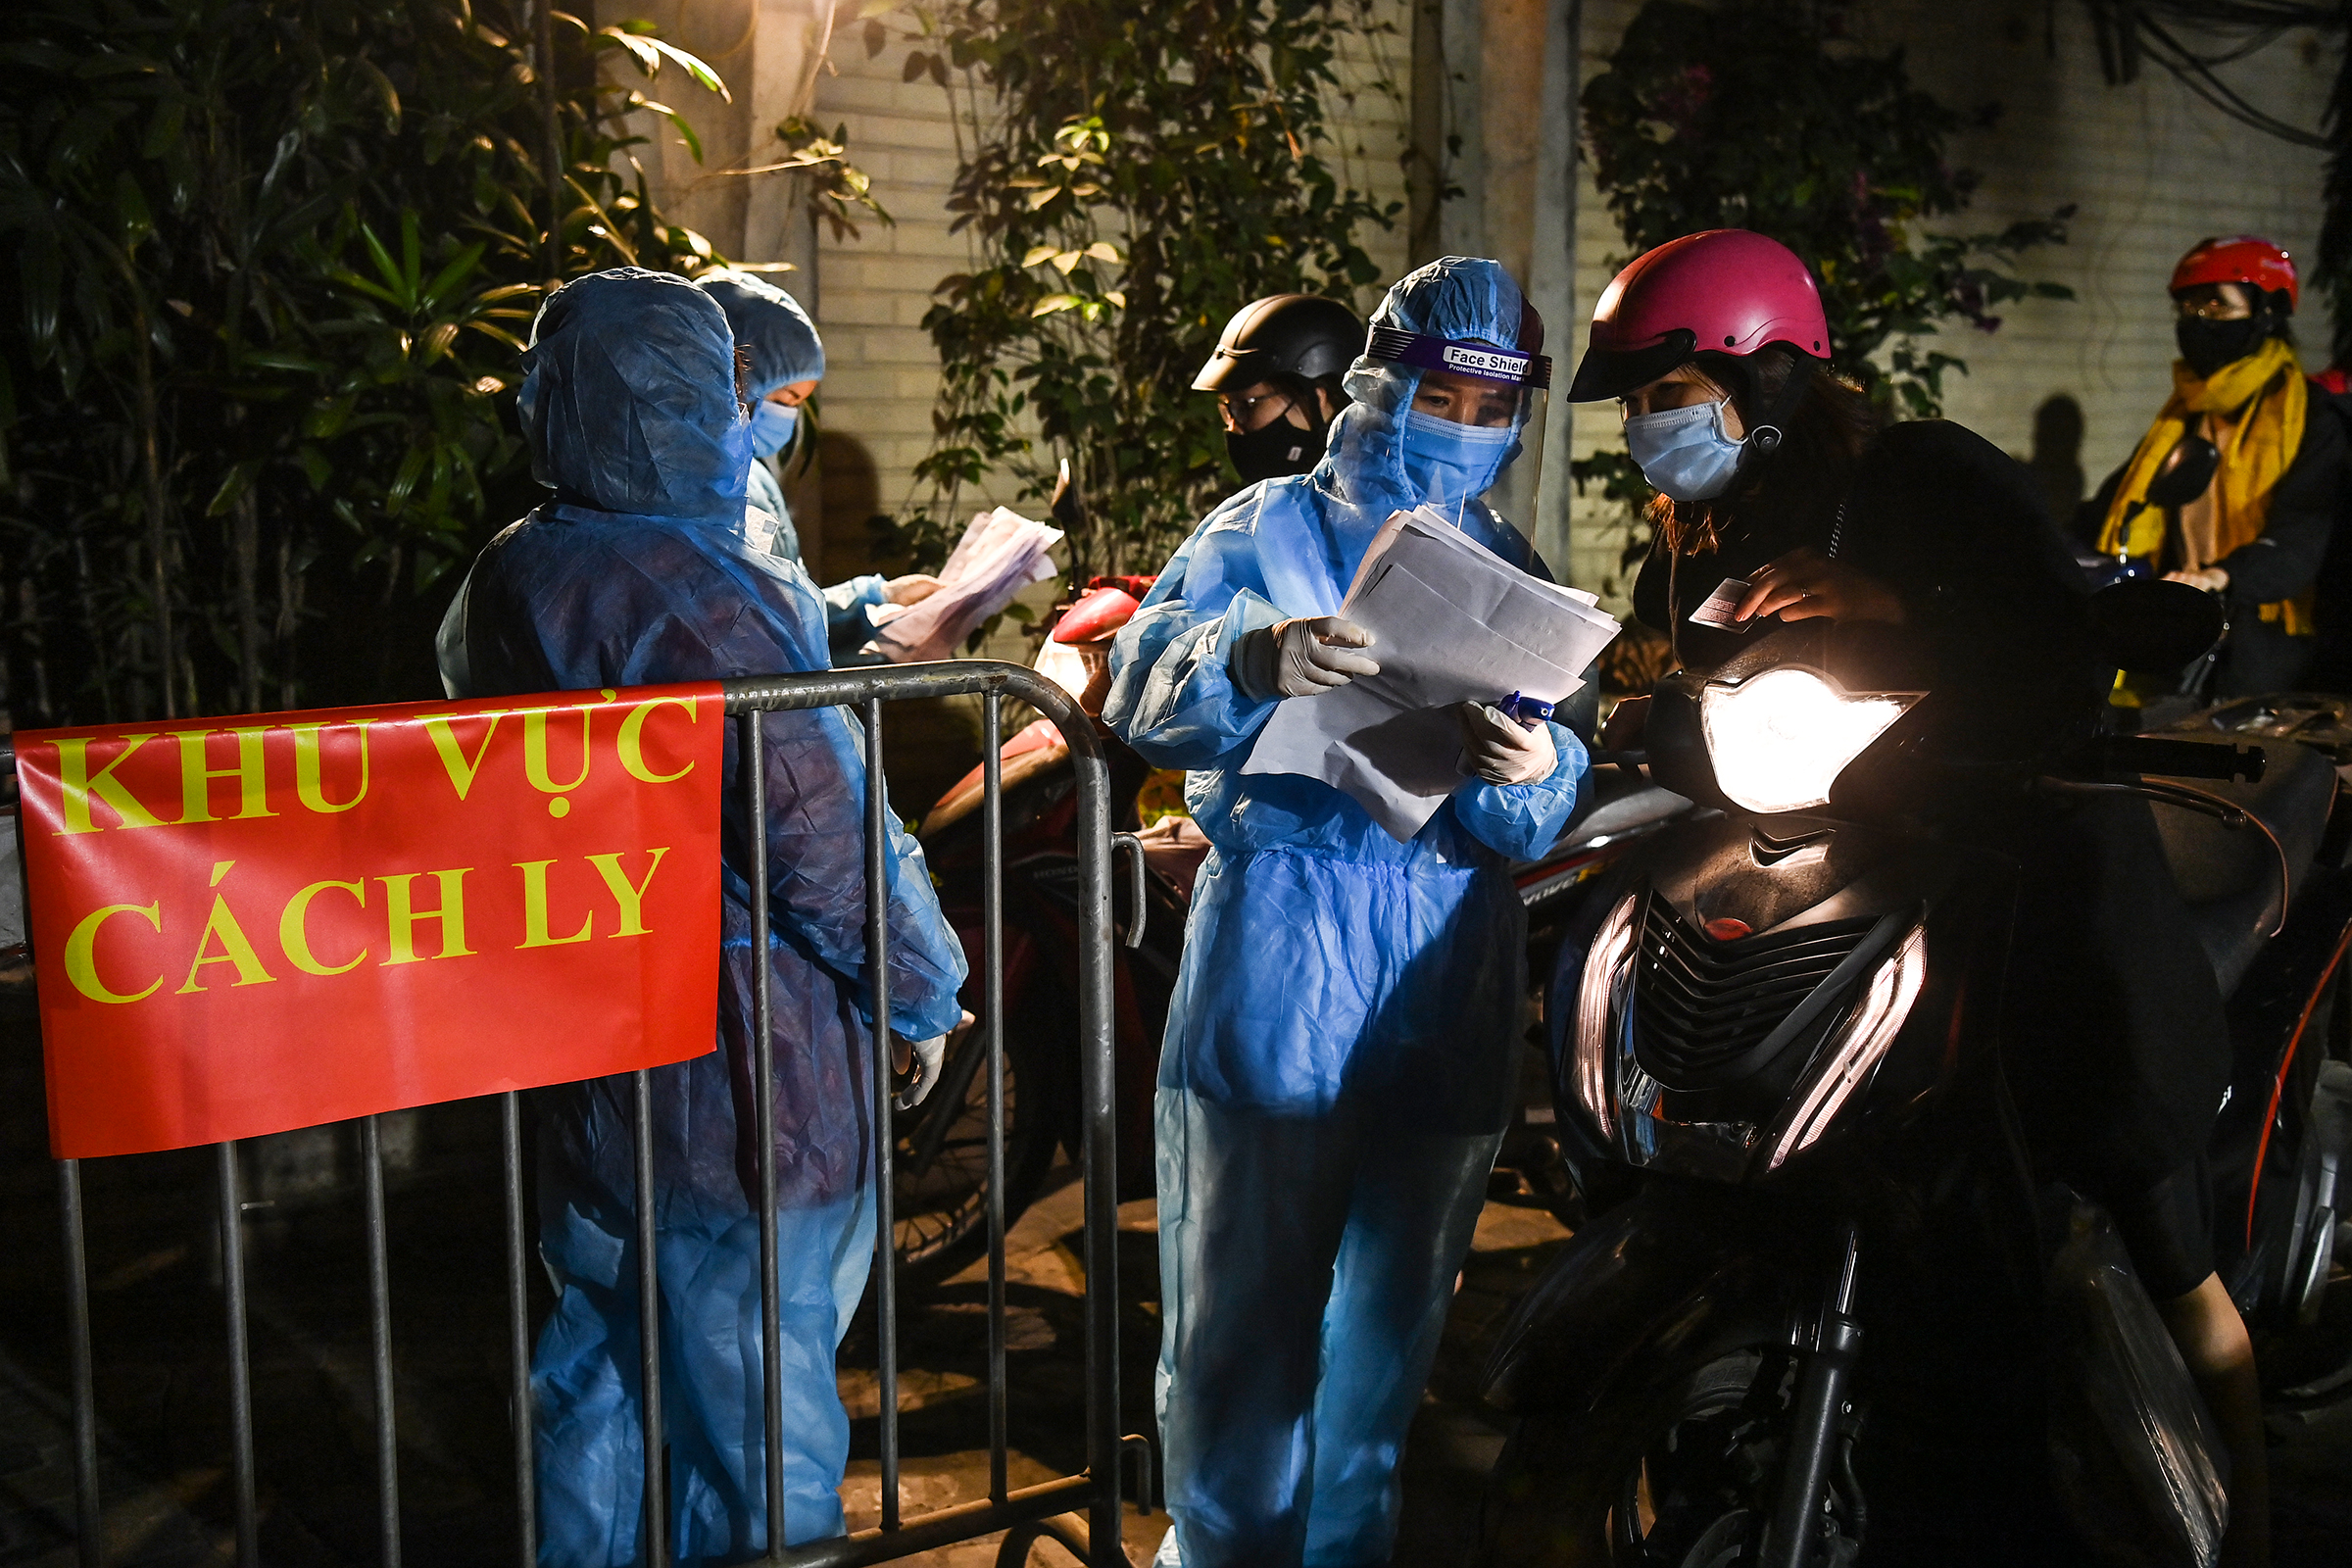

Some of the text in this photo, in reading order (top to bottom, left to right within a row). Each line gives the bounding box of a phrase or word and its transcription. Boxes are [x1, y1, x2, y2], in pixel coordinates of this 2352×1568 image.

[1448, 364, 1483, 375] Protective
[1483, 370, 1510, 380] Isolation
[1450, 349, 1530, 373] Face Shield
[44, 688, 698, 836] KHU VỰC
[64, 847, 670, 1004] CÁCH LY
